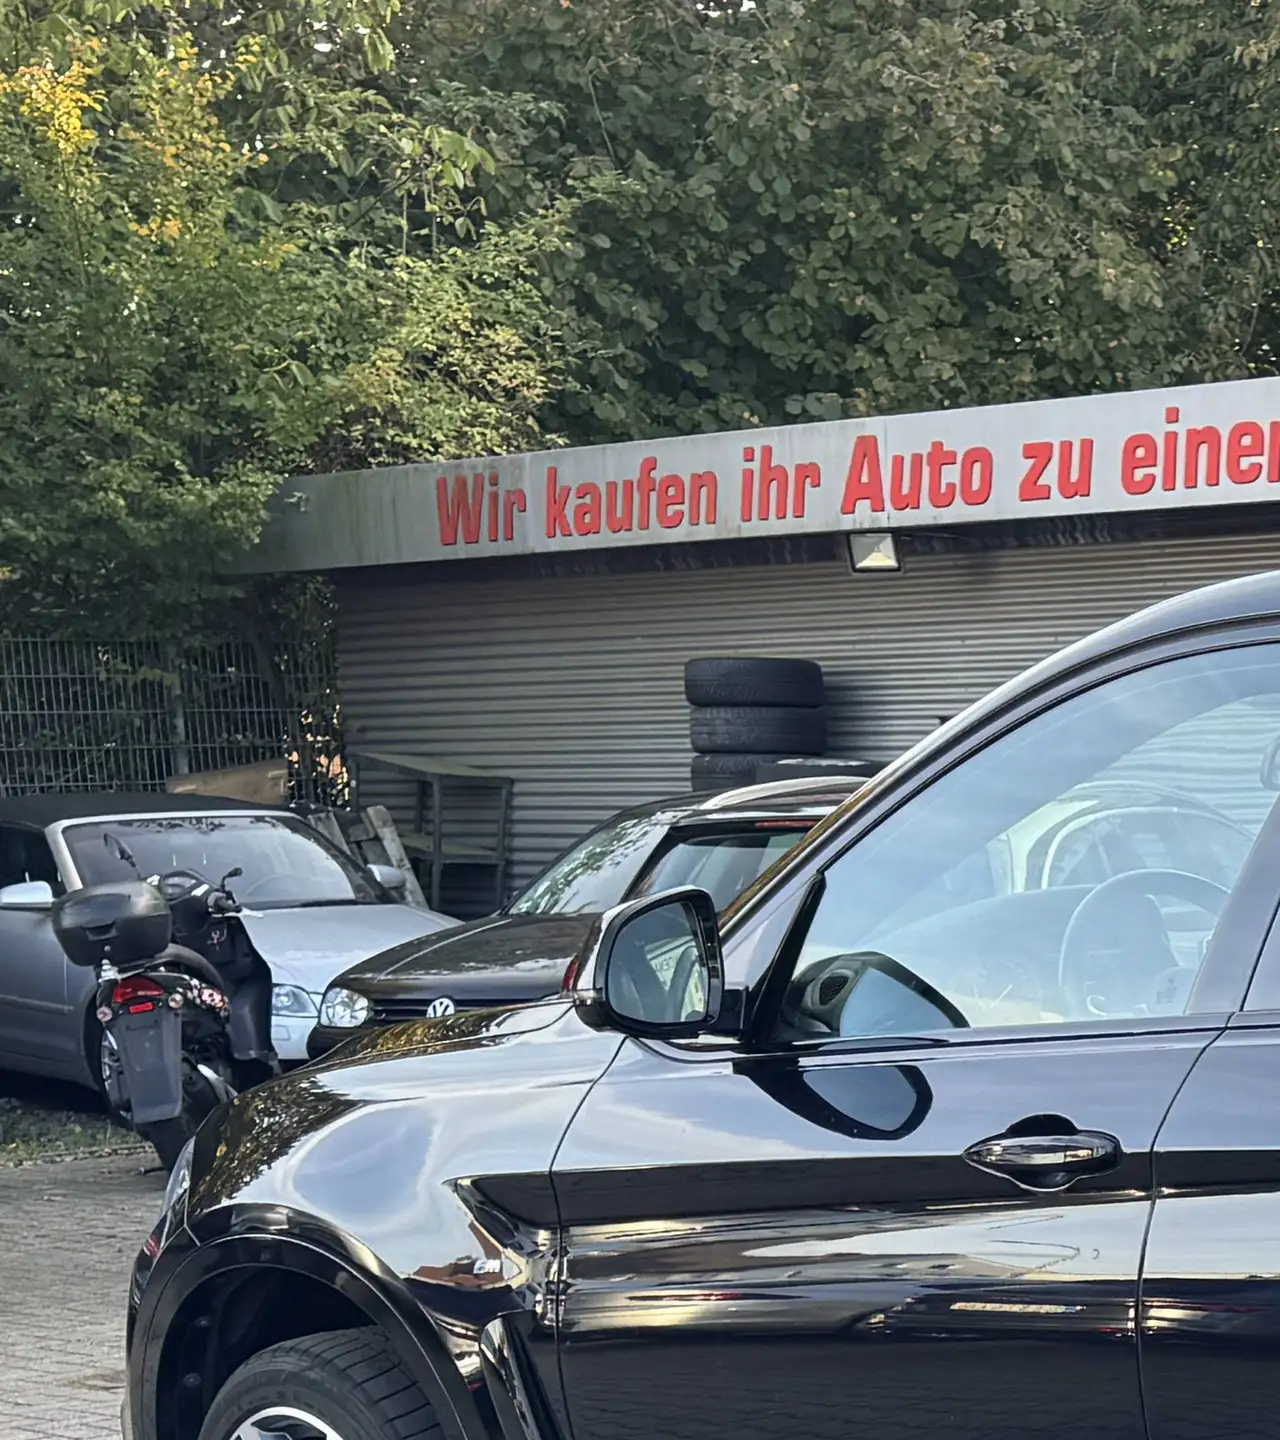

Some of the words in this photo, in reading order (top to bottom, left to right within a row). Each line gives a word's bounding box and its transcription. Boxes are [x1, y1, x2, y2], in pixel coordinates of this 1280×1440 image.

[438, 473, 527, 546] Wir
[545, 457, 718, 539] kaufen
[741, 444, 821, 523] ihr
[841, 435, 993, 516] Auto
[1018, 438, 1094, 502] zu
